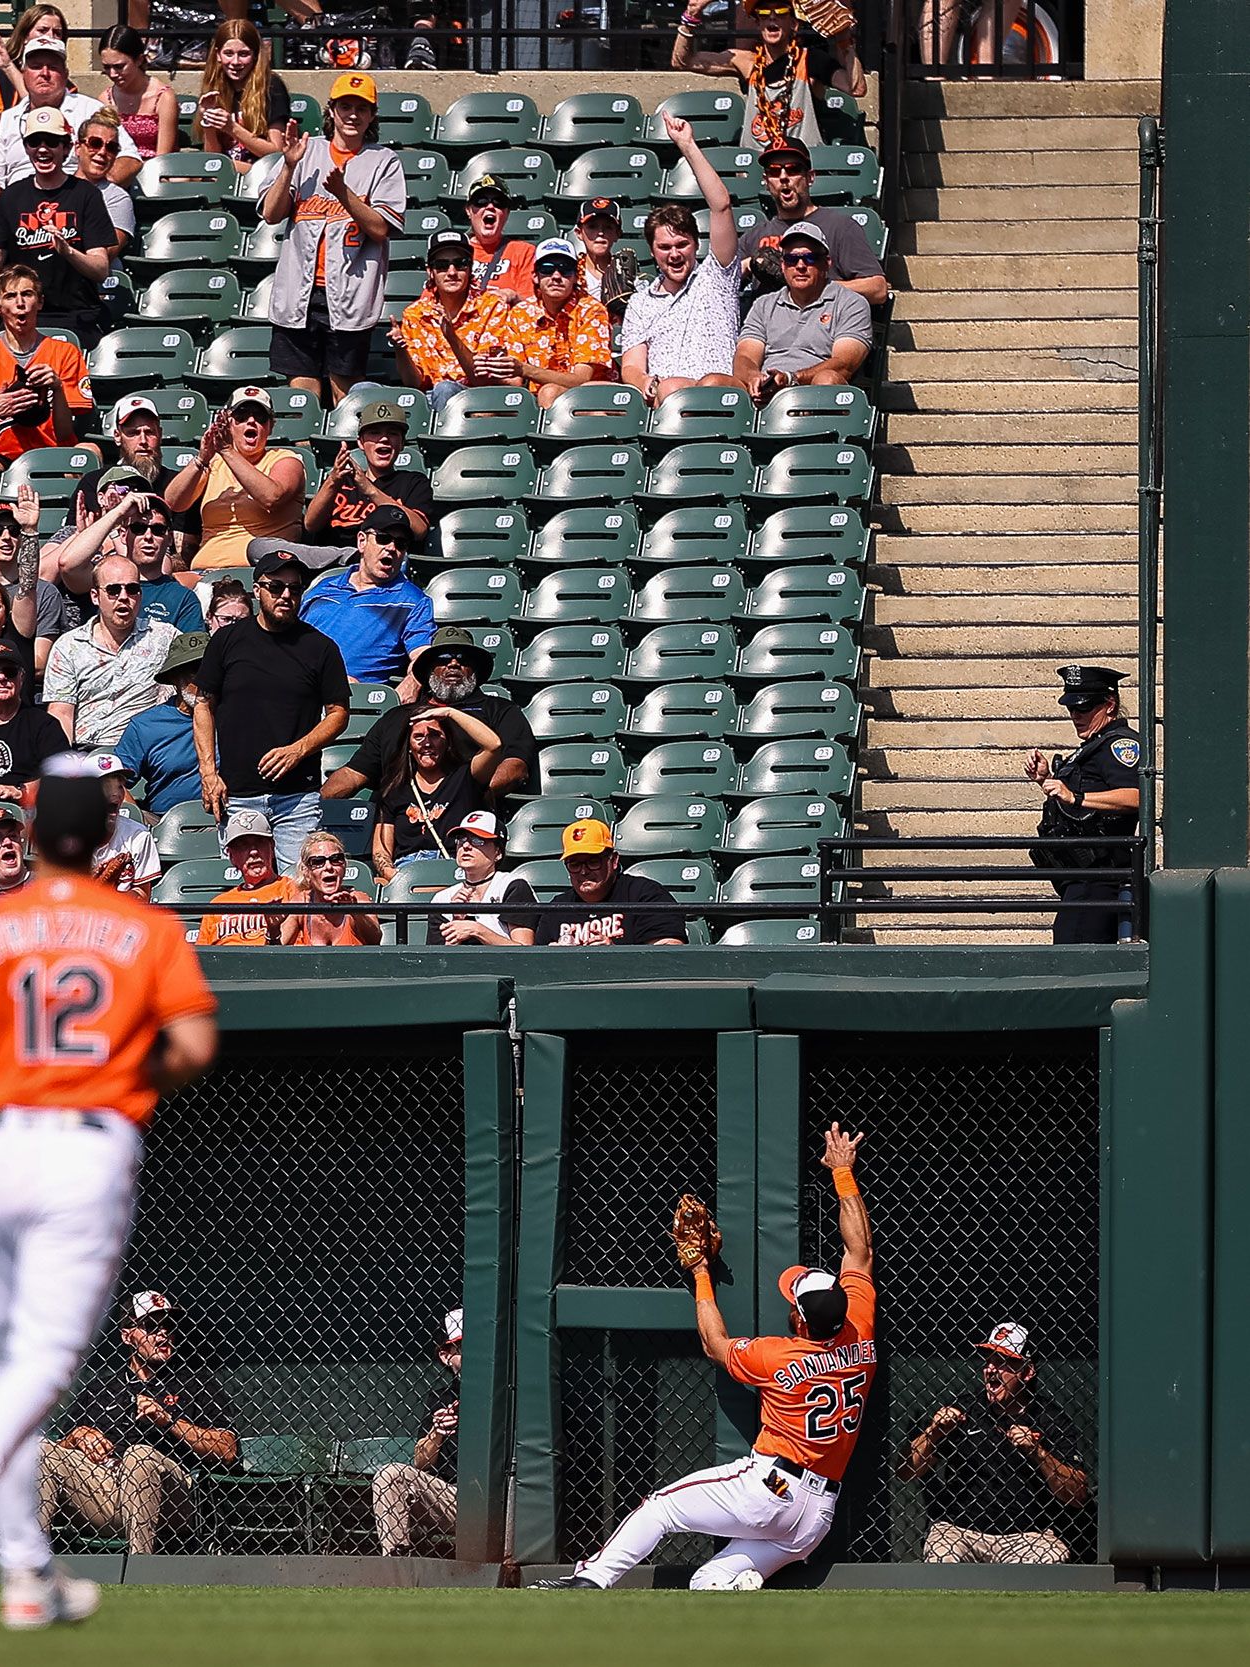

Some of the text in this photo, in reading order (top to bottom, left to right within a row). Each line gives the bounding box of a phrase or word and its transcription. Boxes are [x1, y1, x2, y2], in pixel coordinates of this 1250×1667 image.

[16, 226, 78, 247] Baltimre
[344, 221, 361, 247] 2
[8, 955, 114, 1066] 12
[772, 1338, 878, 1393] SANTANDER
[805, 1373, 867, 1440] 25
